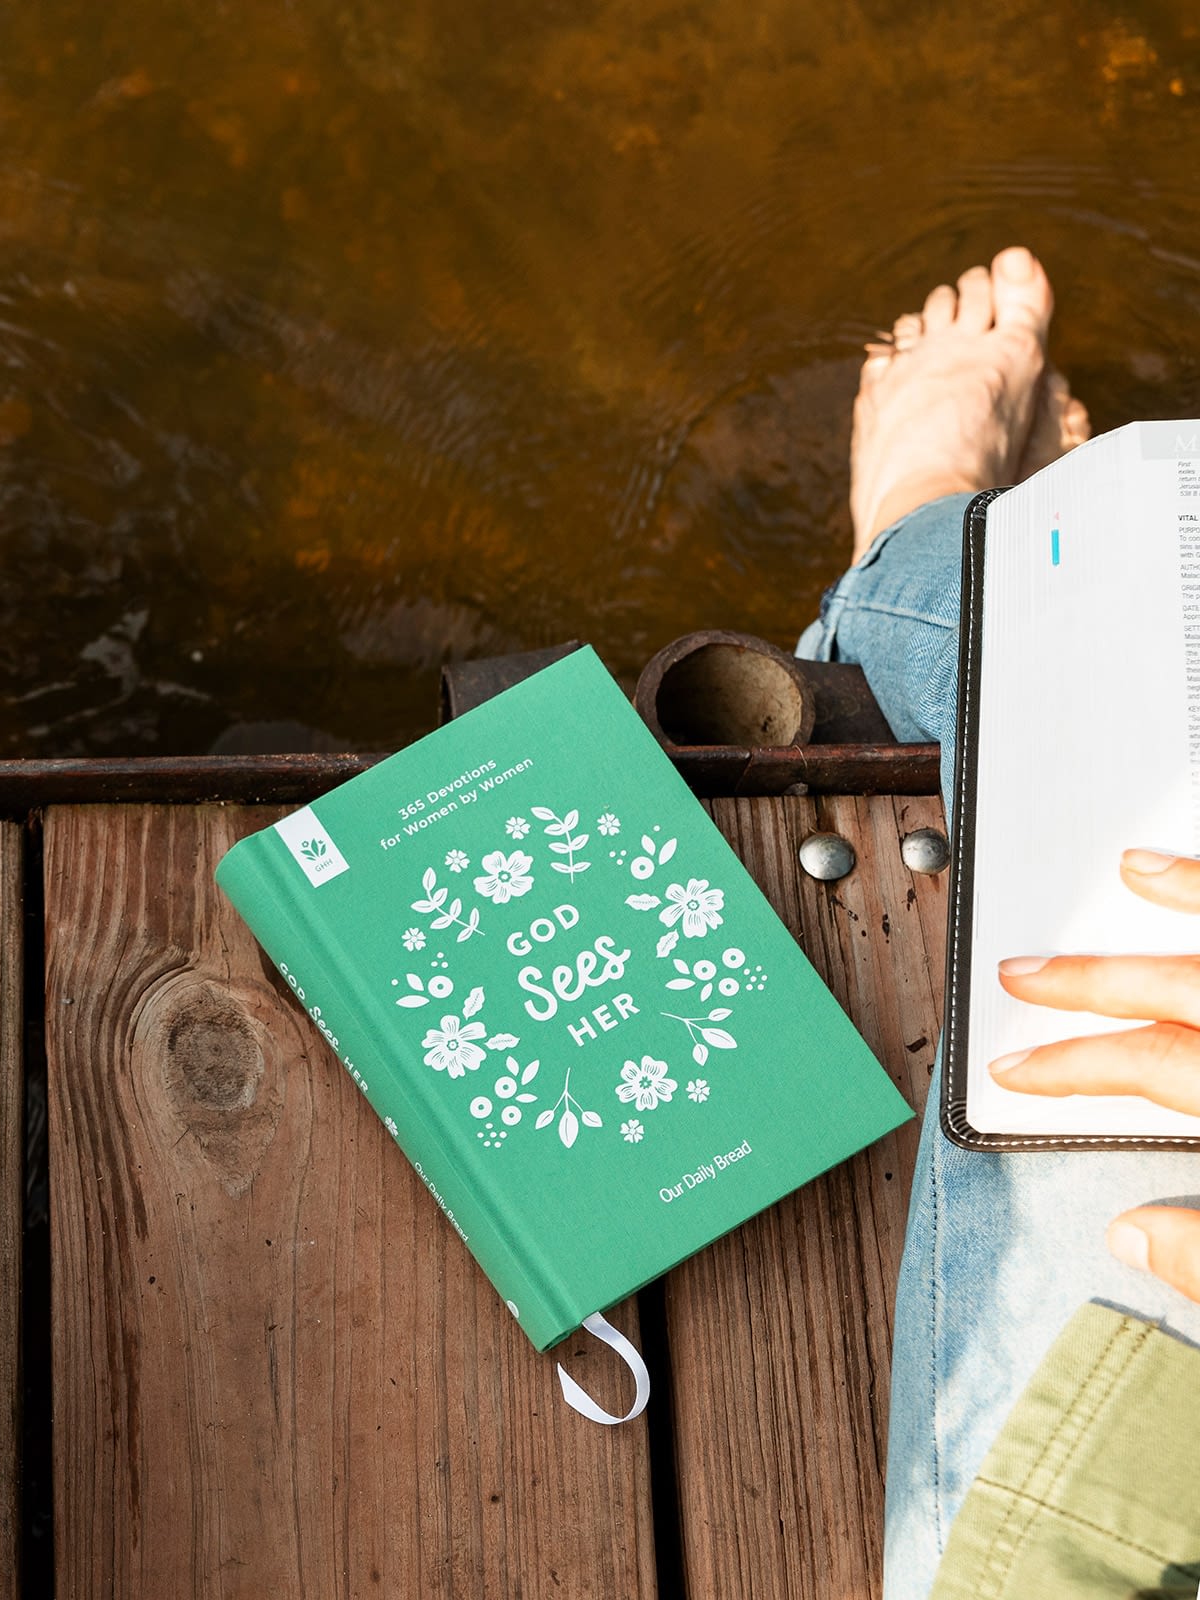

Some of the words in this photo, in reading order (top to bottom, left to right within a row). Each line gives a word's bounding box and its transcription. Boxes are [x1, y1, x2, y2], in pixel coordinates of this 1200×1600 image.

[381, 834, 400, 849] for
[403, 803, 457, 835] Women
[459, 790, 477, 804] by
[479, 759, 533, 791] Women
[399, 800, 425, 819] 365
[427, 760, 496, 803] Devotions
[507, 904, 579, 956] GOD
[518, 936, 631, 1021] Sees
[280, 963, 305, 999] GOD
[310, 1007, 338, 1051] Sees
[344, 1057, 368, 1091] HER
[567, 994, 640, 1046] HER
[415, 1163, 427, 1181] Our
[429, 1183, 446, 1209] Daily
[447, 1210, 468, 1241] Bread
[660, 1183, 683, 1202] Our
[683, 1165, 715, 1188] Daily
[714, 1140, 752, 1170] Bread
